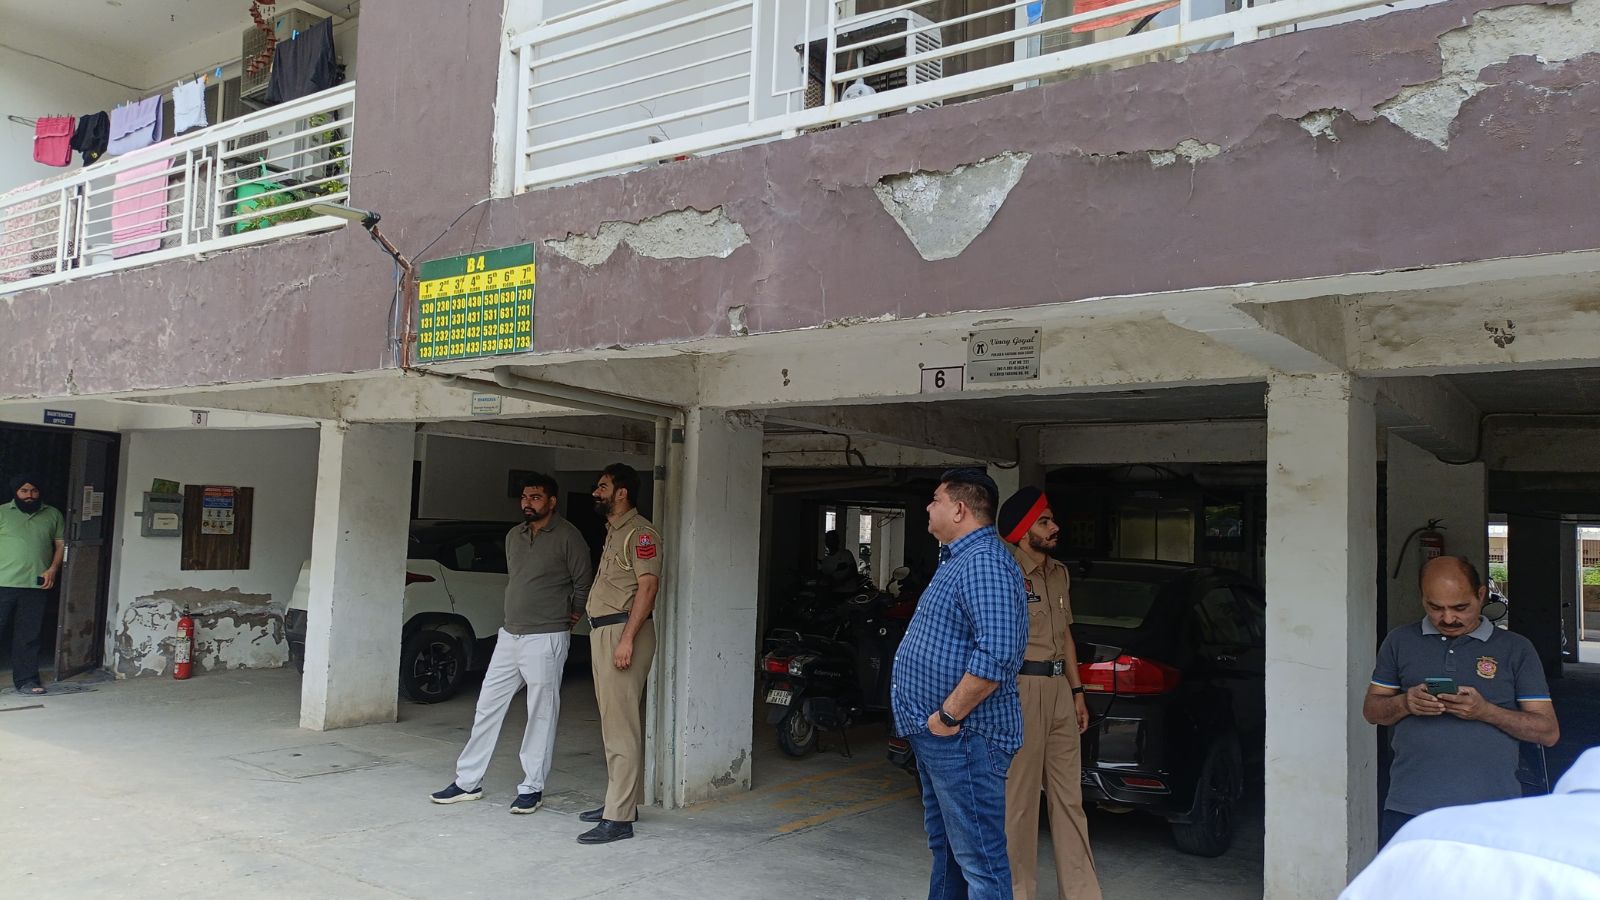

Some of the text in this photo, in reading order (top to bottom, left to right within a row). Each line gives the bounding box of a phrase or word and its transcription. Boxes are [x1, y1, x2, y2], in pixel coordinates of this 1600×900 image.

[467, 256, 485, 272] B4
[422, 289, 531, 314] 130 230 330 430 530 630 730
[421, 305, 530, 328] 131 231 331 431 531 631 731
[420, 320, 530, 343] 132 232 332 432 532 632 732
[420, 336, 530, 358] 133 233 333 433 533 633 733
[935, 370, 945, 388] 6
